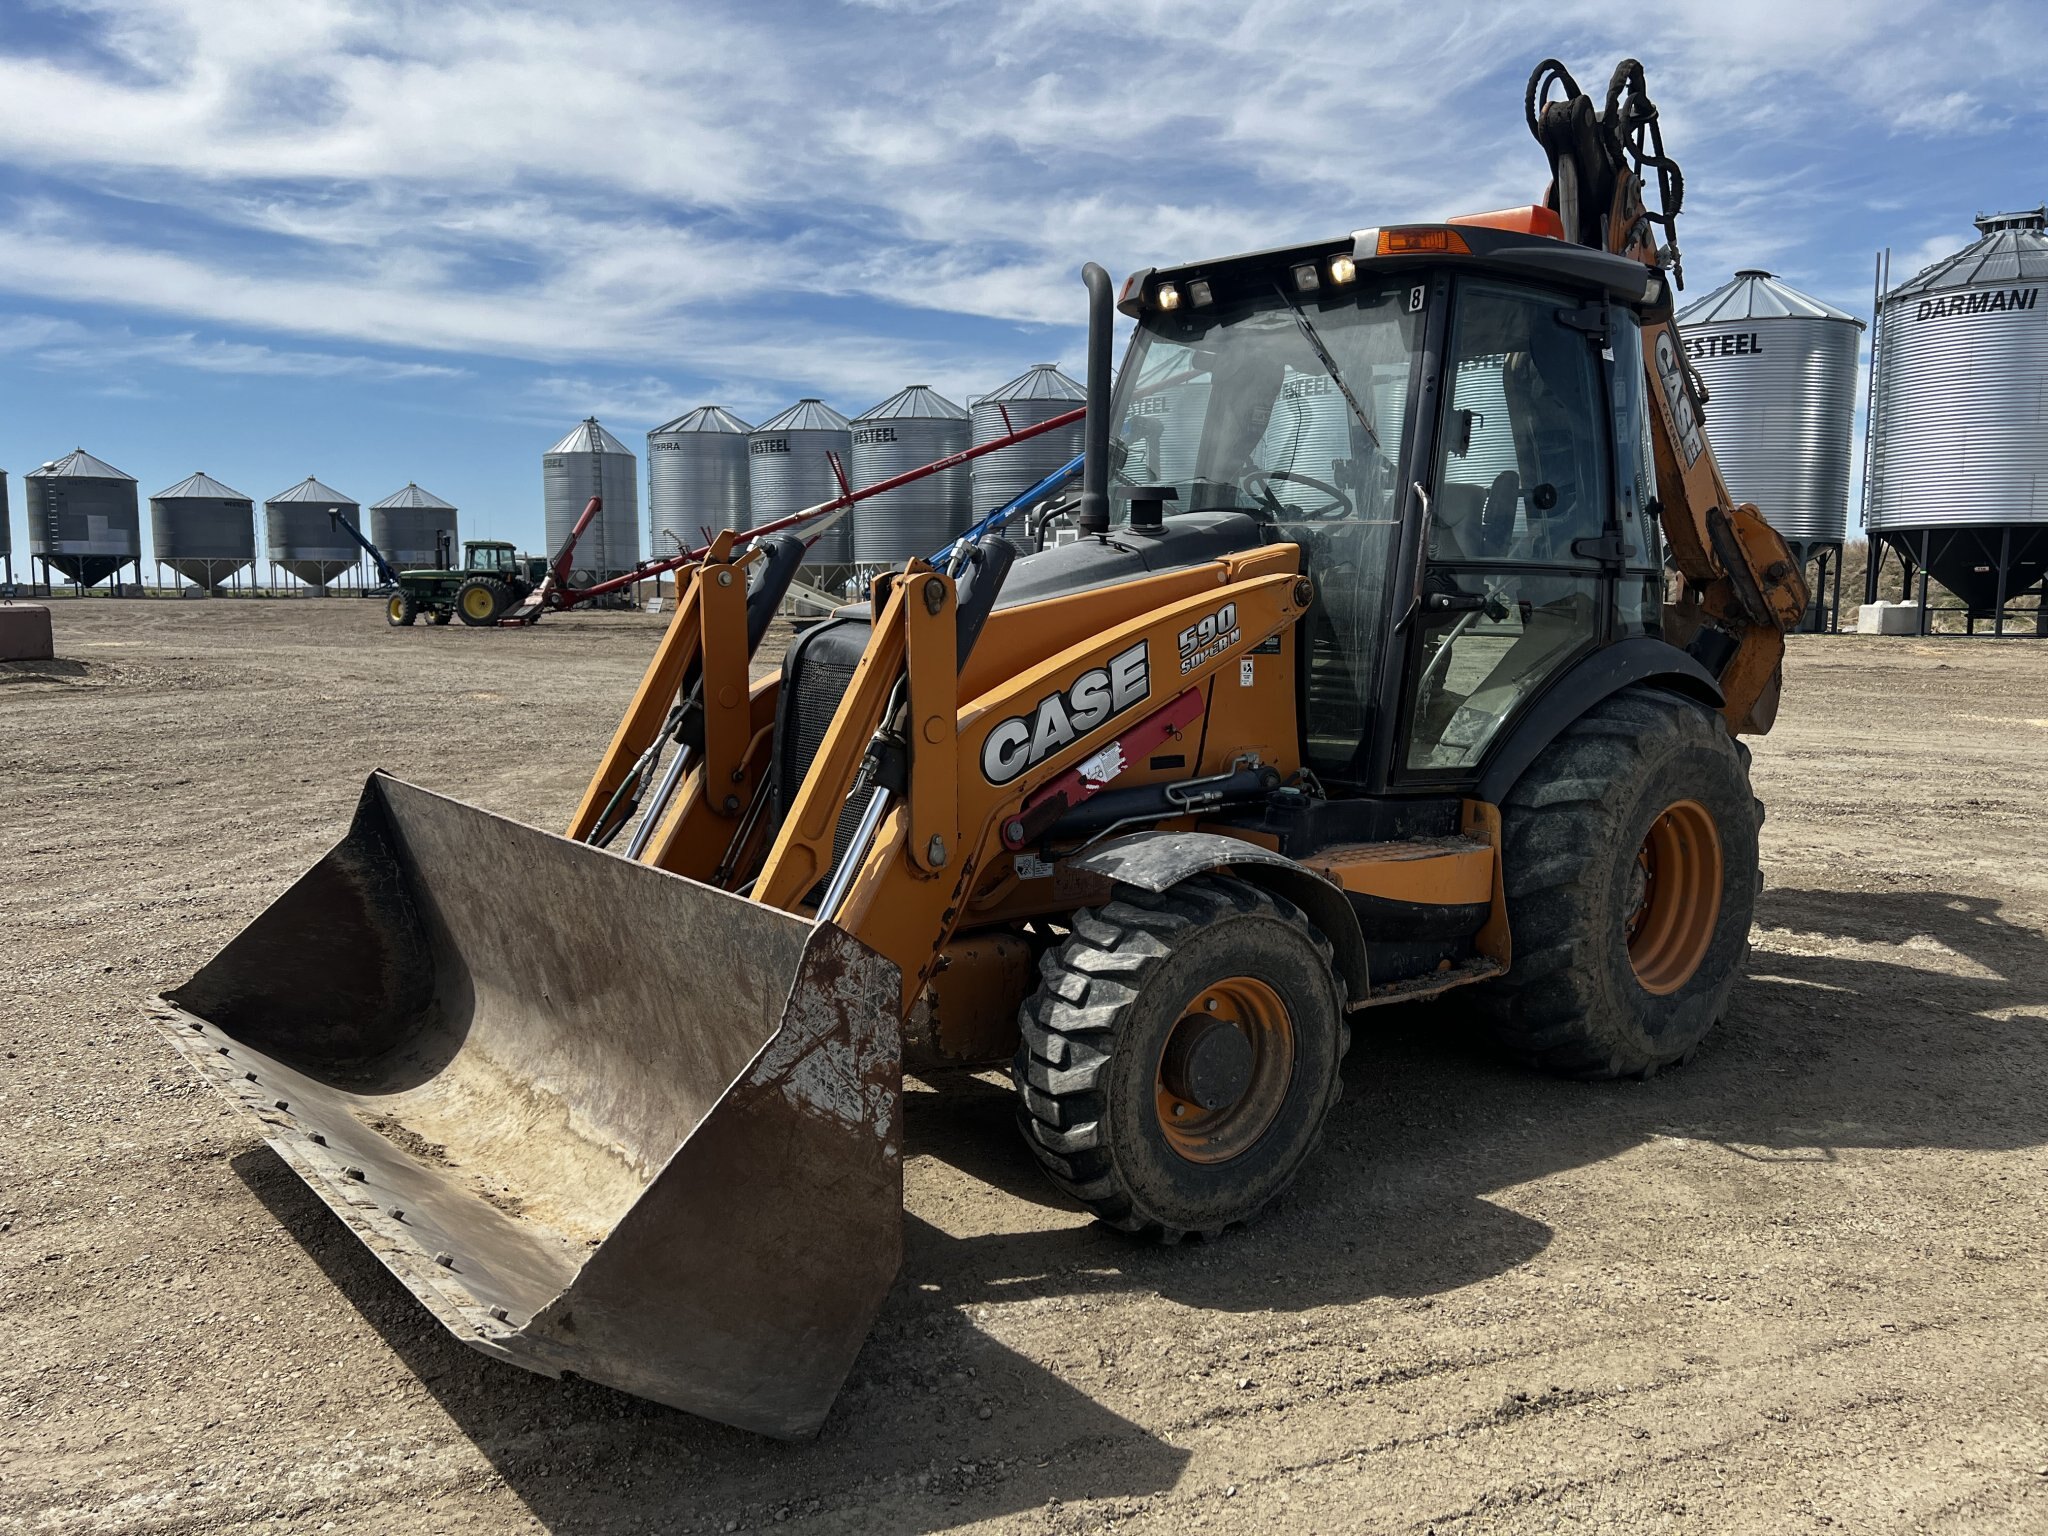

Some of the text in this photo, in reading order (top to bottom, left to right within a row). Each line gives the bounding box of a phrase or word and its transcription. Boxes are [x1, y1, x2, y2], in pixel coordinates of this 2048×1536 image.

[1411, 288, 1421, 309] 8
[1916, 288, 2038, 321] DARMANI
[1682, 333, 1763, 359] ESTEEL
[1655, 330, 1703, 470] CASE
[1178, 602, 1236, 659] 590
[1180, 635, 1229, 675] SUPER
[1229, 627, 1241, 645] N
[982, 639, 1149, 784] CASE
